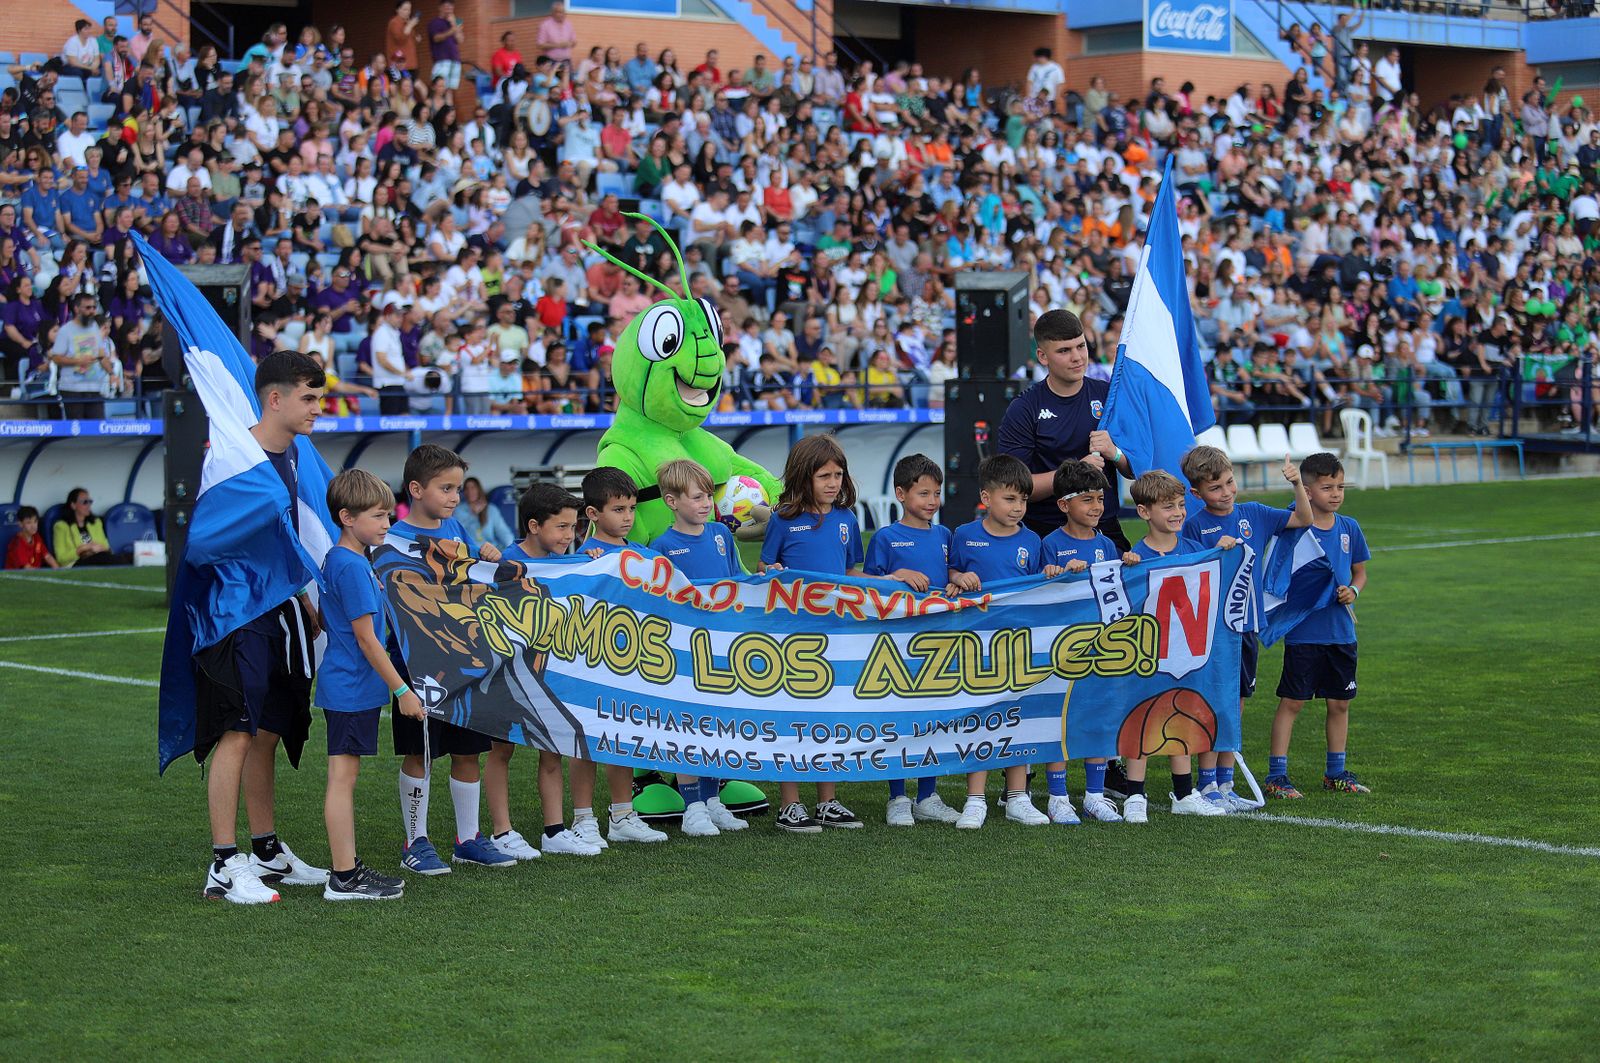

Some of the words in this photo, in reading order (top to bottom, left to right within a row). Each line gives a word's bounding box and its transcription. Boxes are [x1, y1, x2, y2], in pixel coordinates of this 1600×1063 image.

[99, 421, 151, 436] Cruzcampo
[1156, 571, 1210, 659] N
[476, 594, 677, 685] ¡VAMOS
[690, 627, 835, 699] LOS
[853, 613, 1160, 699] AZULES!
[597, 696, 778, 742] LUCHAREMOS
[790, 722, 899, 744] TODOS
[912, 707, 1021, 737] UNIDOS
[596, 731, 763, 771] ALZAREMOS
[772, 748, 888, 773] FUERTE
[901, 746, 940, 768] LA
[954, 736, 1037, 763] VOZ...
[408, 800, 421, 840] PlayStation
